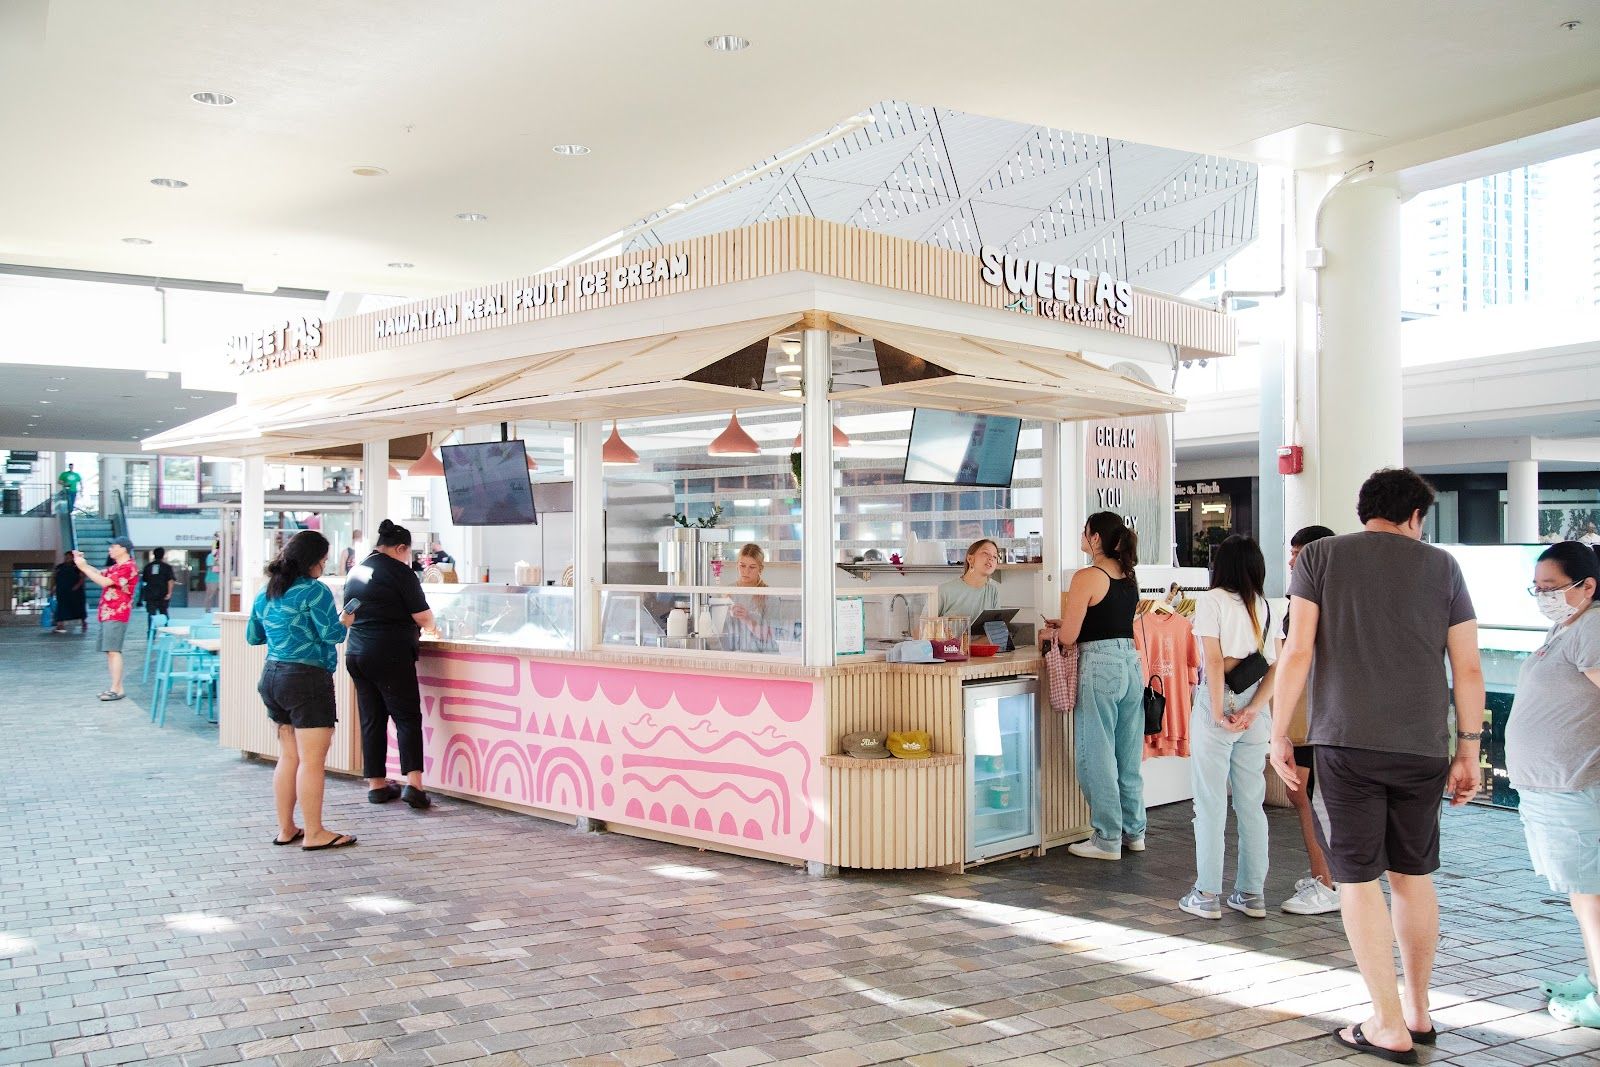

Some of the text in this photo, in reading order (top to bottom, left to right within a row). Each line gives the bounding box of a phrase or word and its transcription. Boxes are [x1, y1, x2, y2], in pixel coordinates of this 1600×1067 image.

[464, 294, 506, 321] REAL
[512, 279, 568, 310] FRUIT
[576, 270, 608, 299] ICE
[615, 253, 688, 290] CREAM
[980, 245, 1133, 316] SWEET AS
[293, 313, 322, 350] AS
[1096, 426, 1136, 448] CREAM
[1097, 458, 1138, 481] MAKES
[1097, 487, 1122, 508] YOU
[1187, 485, 1196, 495] &
[1493, 767, 1509, 778] PR
